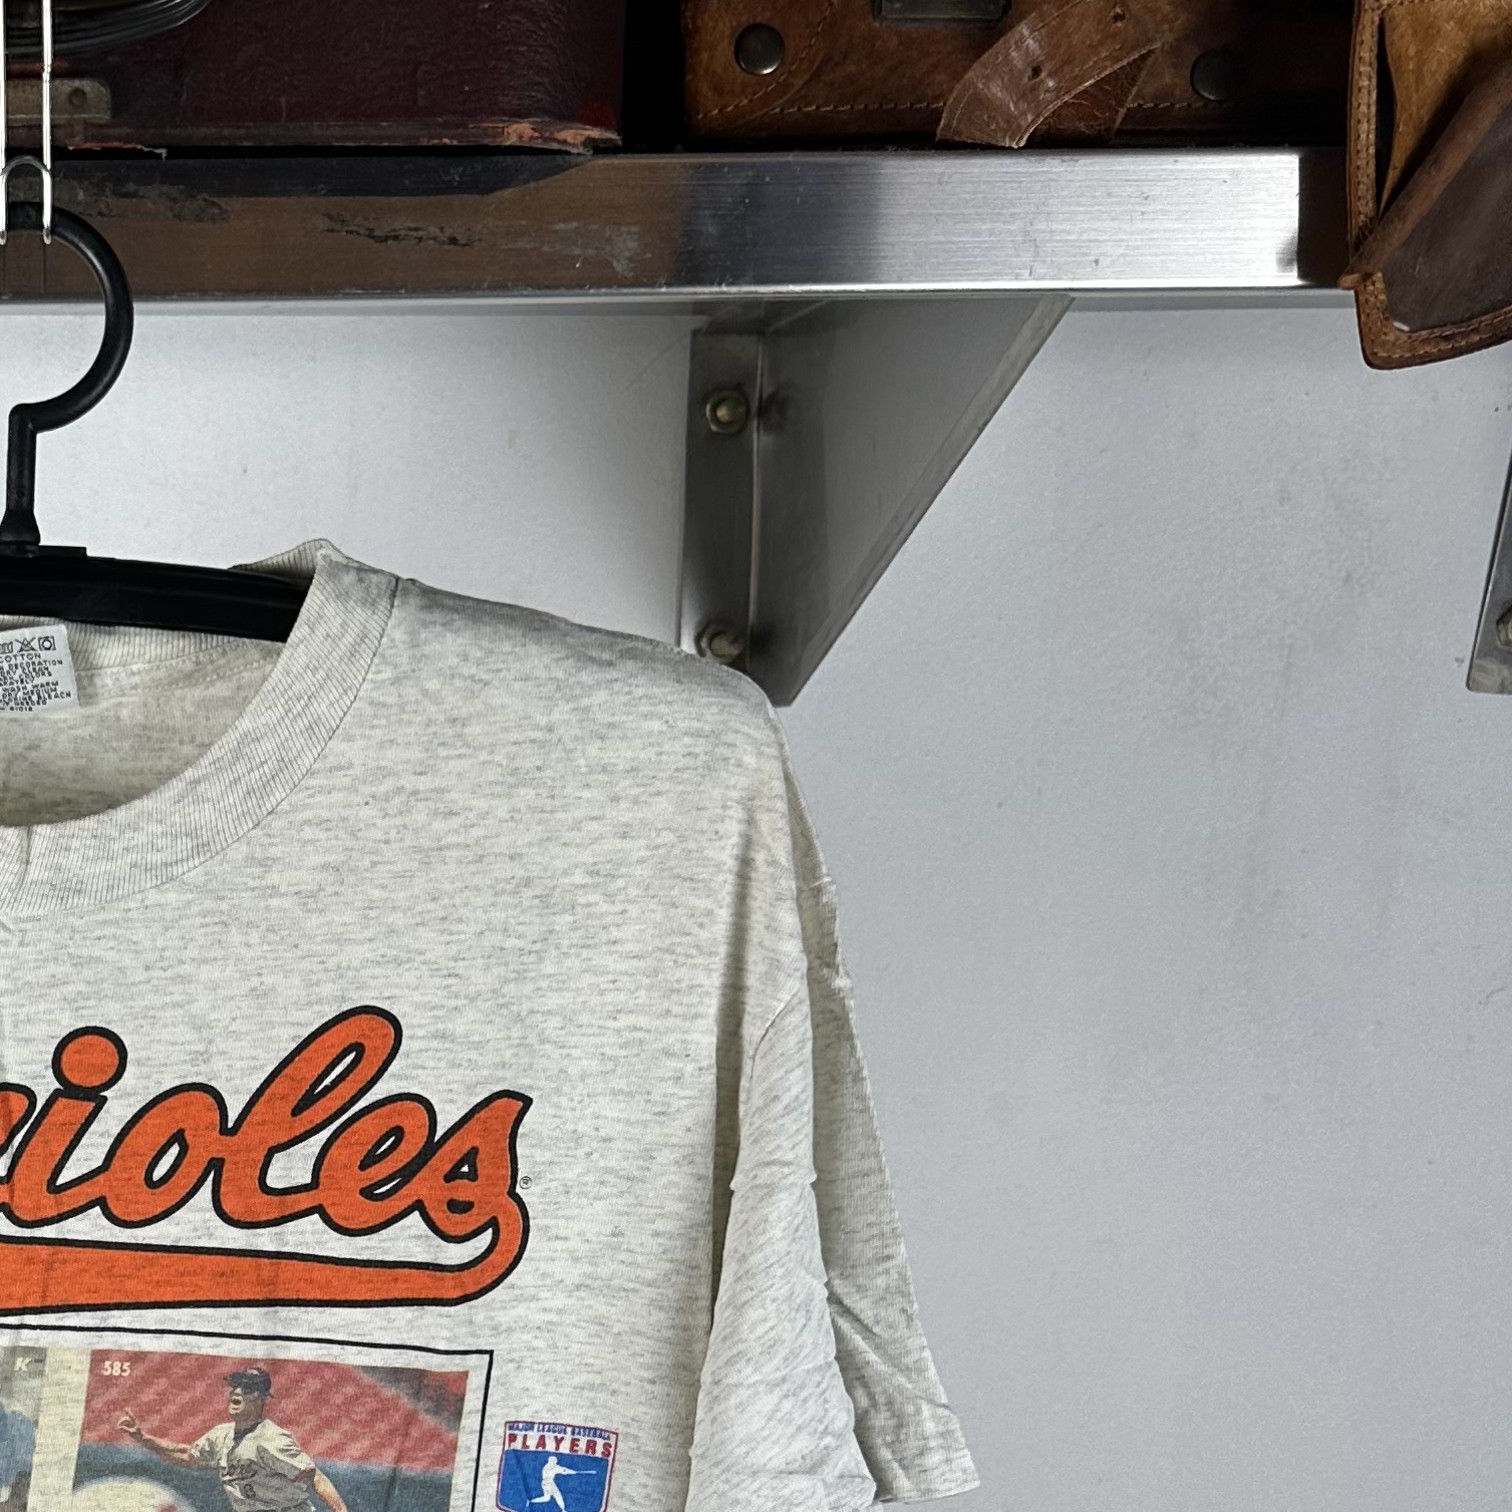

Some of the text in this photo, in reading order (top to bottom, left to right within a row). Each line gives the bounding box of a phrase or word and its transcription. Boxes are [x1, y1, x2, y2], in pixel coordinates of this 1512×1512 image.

[8, 659, 63, 671] DECORATION
[102, 1359, 132, 1377] 585
[507, 1433, 613, 1458] PLAYERS
